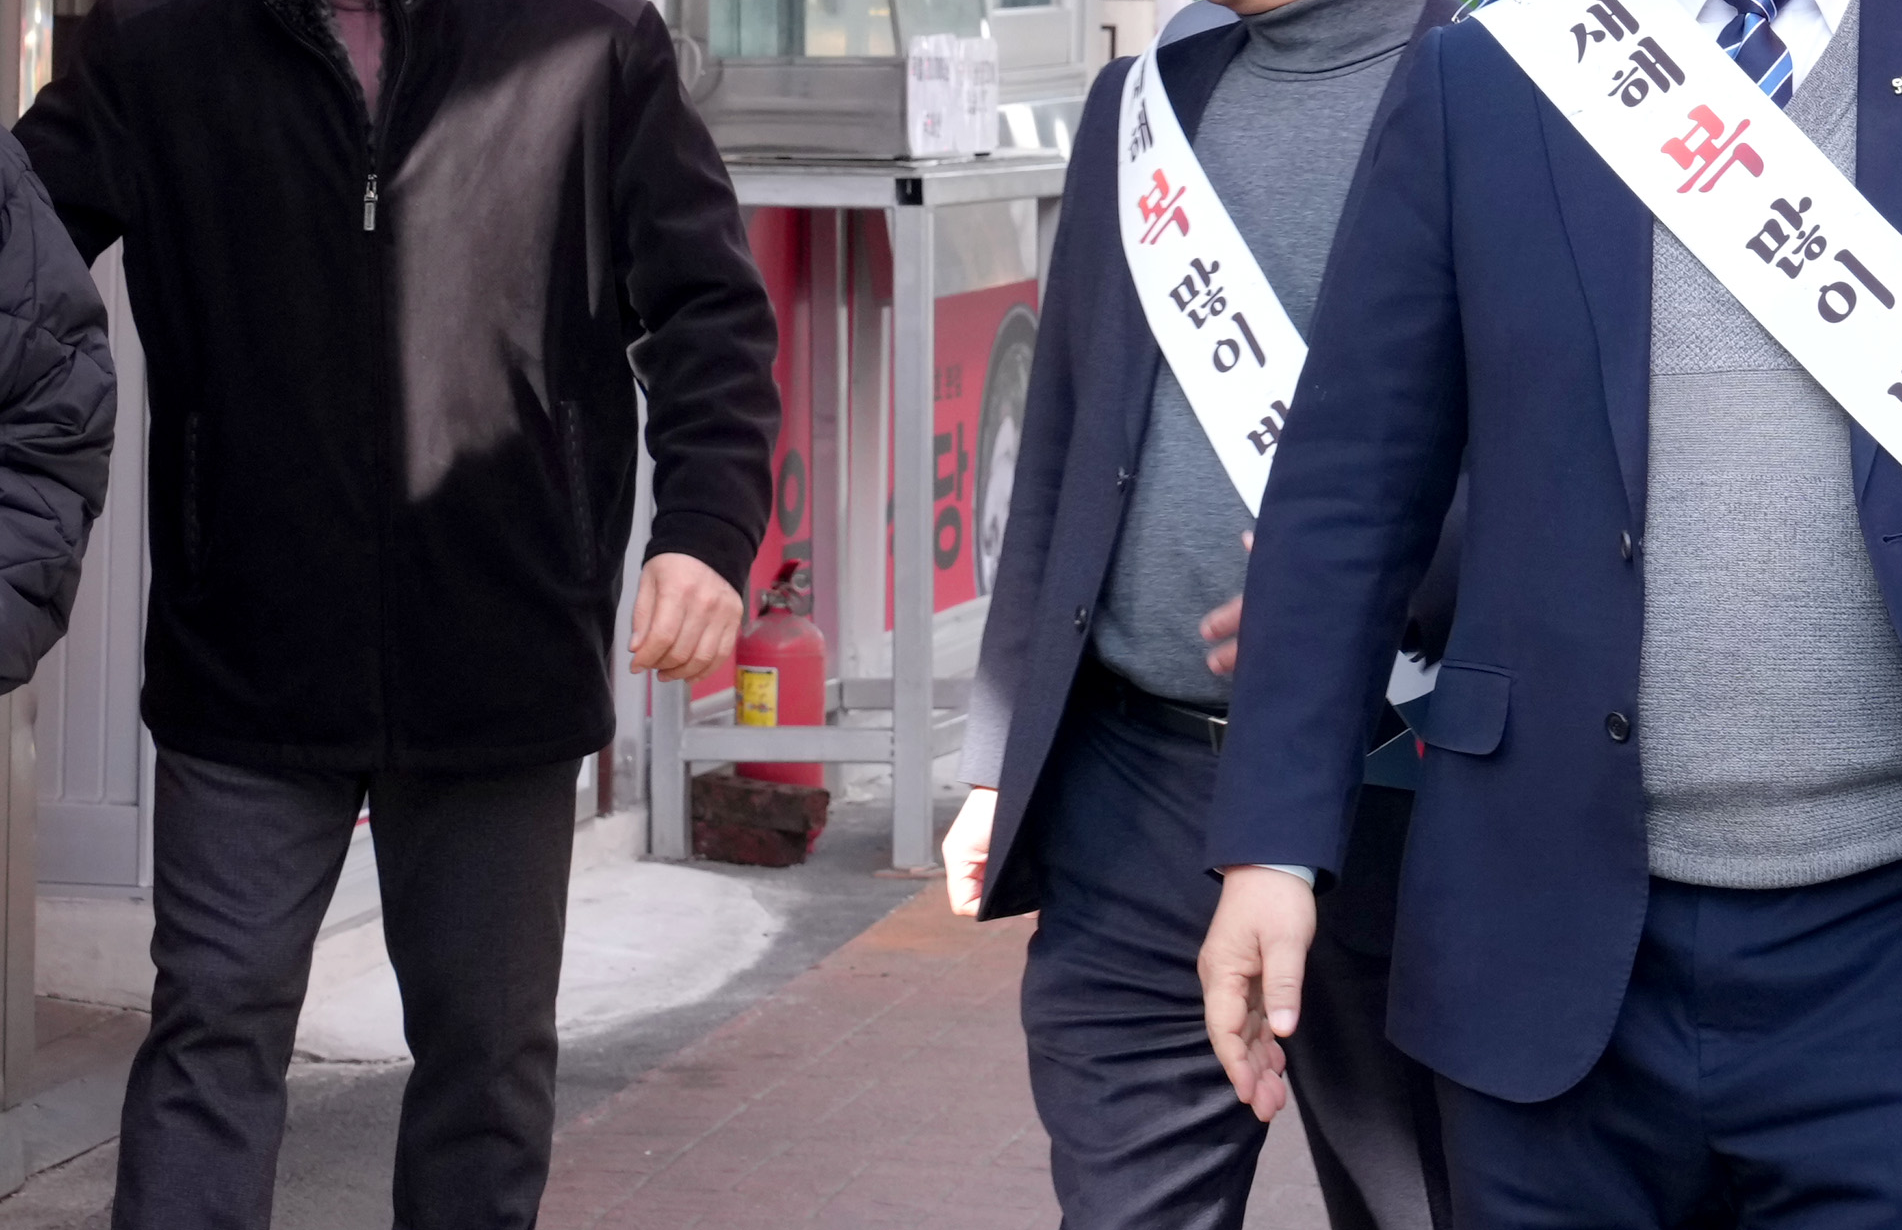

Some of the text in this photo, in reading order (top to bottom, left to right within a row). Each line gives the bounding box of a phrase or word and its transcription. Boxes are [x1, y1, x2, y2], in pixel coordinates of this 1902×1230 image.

[1137, 168, 1190, 245] 복
[1169, 257, 1266, 373] 많이
[1660, 104, 1765, 194] 복
[1745, 196, 1896, 324] 많이
